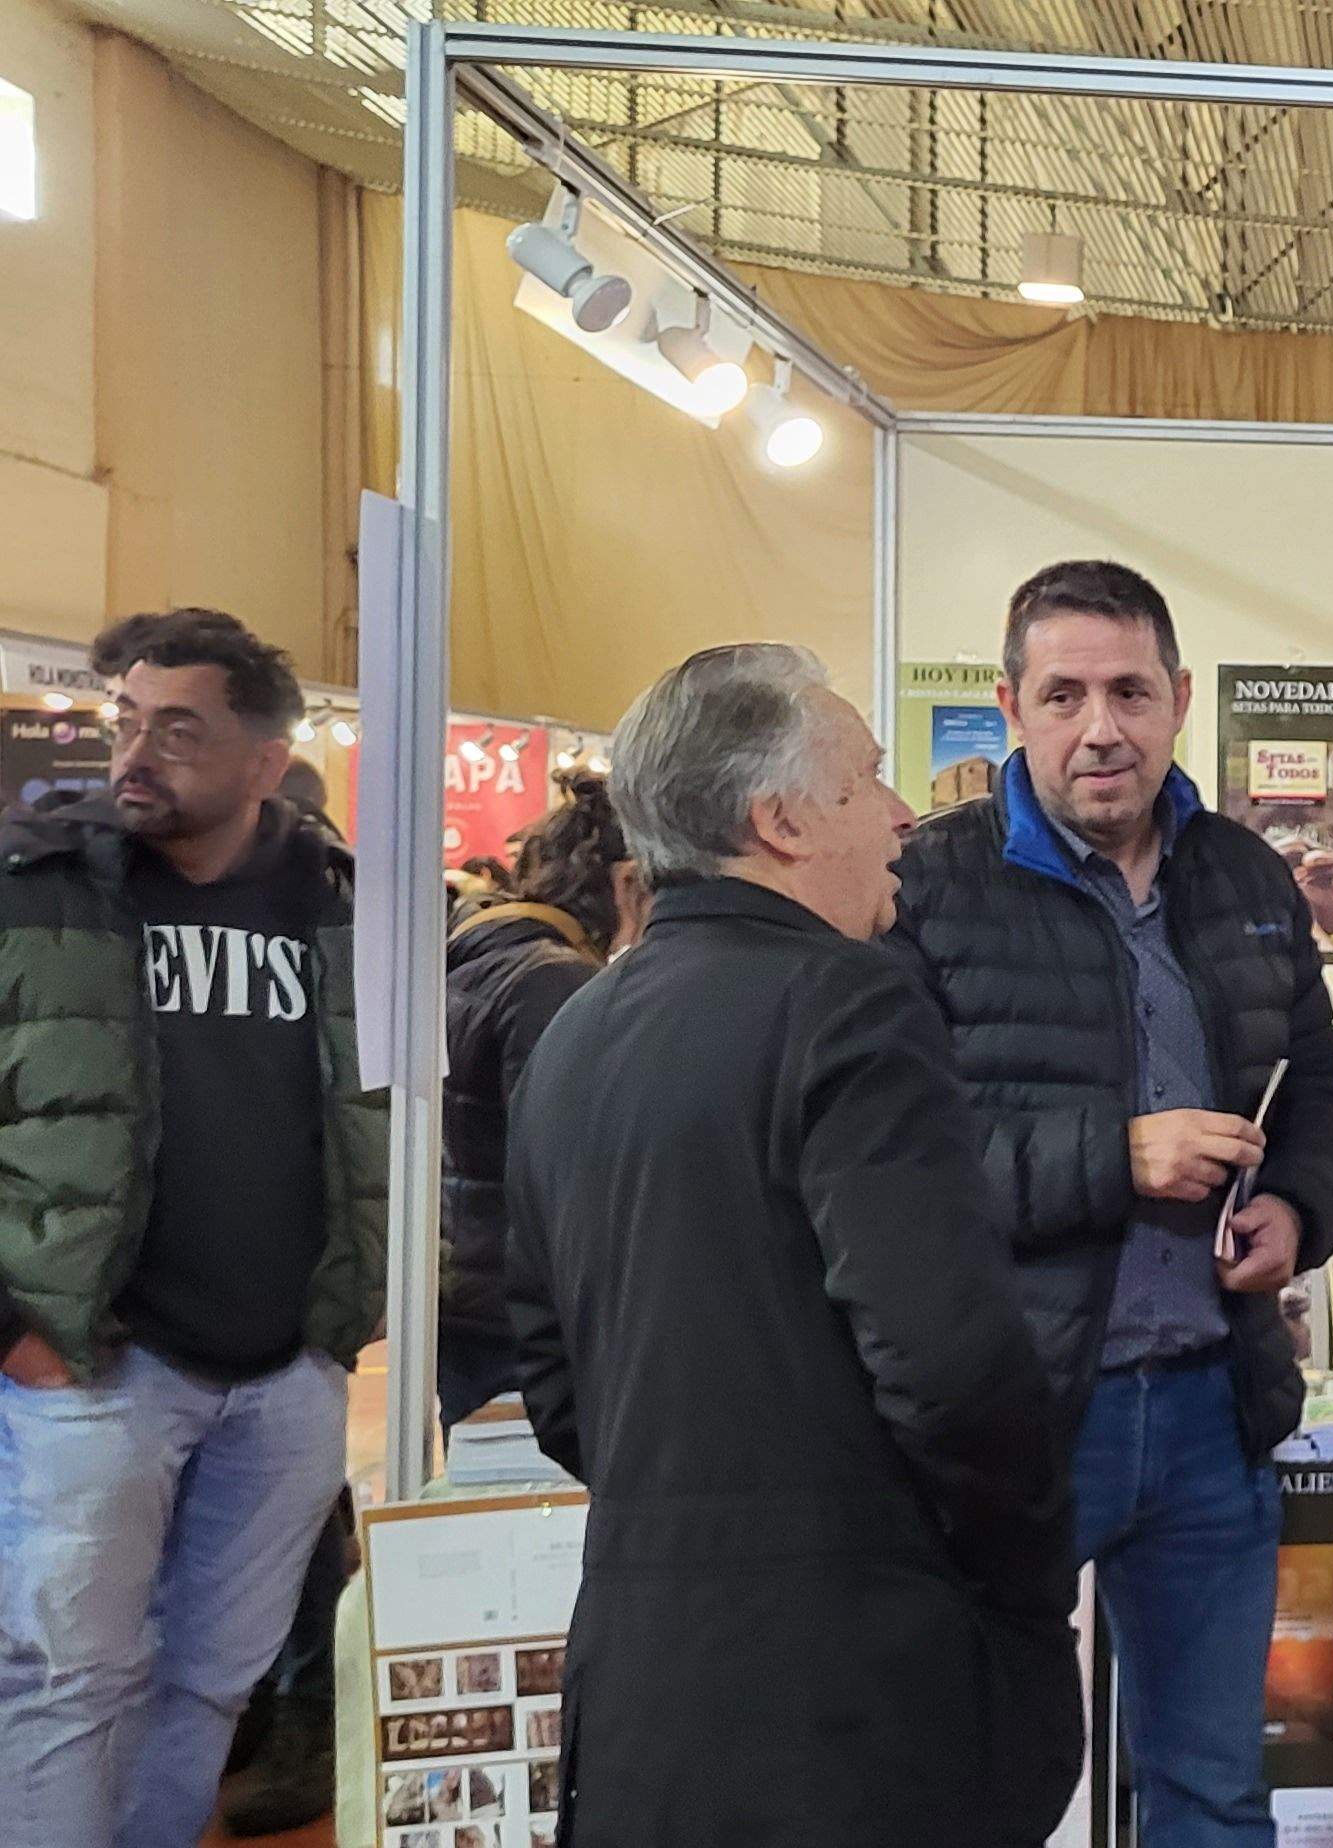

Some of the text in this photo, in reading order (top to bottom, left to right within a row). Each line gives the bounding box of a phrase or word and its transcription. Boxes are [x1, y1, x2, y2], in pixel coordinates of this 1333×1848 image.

[961, 669, 1004, 683] FIR
[444, 754, 526, 793] APA
[143, 923, 308, 1021] EVI'S
